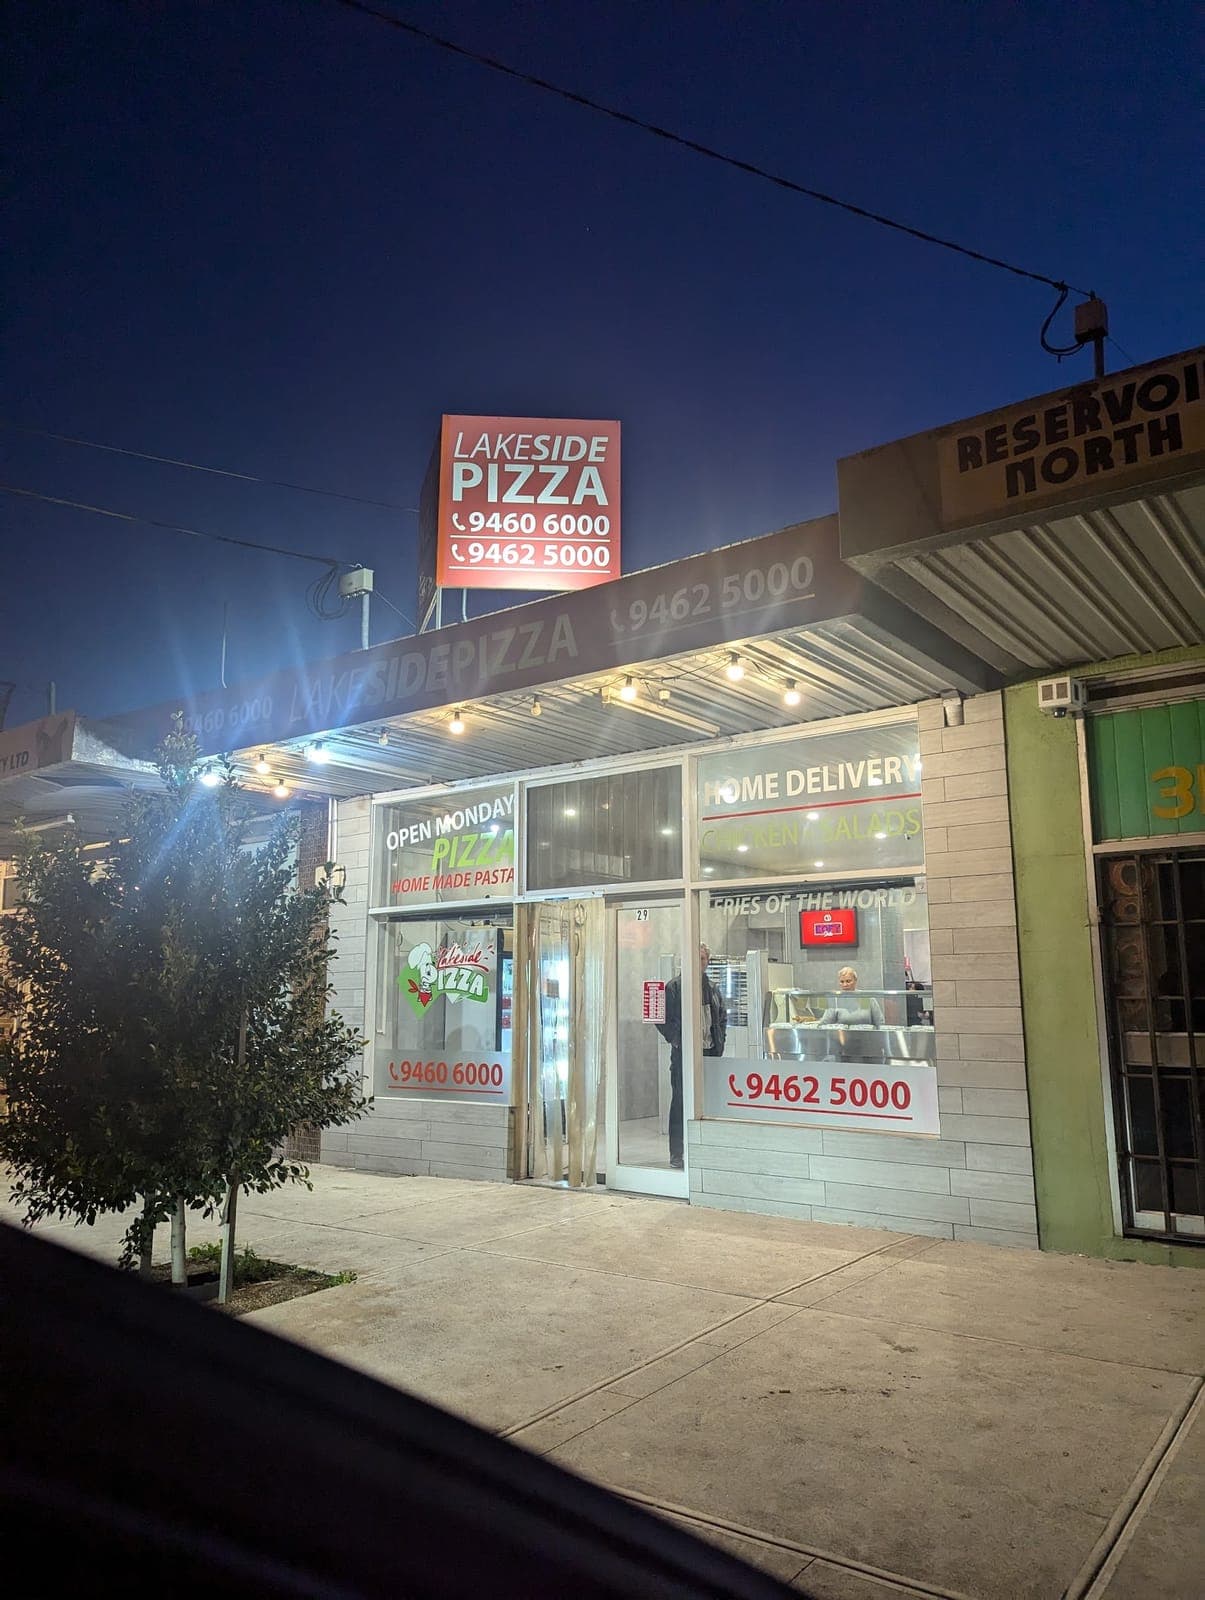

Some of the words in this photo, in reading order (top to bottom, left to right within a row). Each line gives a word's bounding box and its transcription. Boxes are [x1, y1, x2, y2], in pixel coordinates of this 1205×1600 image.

[957, 361, 1205, 474] RESERVOI
[453, 431, 609, 462] LAKESIDE
[1005, 412, 1183, 499] NORTH
[452, 462, 609, 506] PIZZA
[468, 512, 537, 535] 9460
[543, 513, 610, 537] 6000
[467, 542, 536, 566] 9462
[543, 543, 611, 568] 5000
[628, 583, 712, 632] 9462
[720, 555, 815, 602] 5000
[9, 750, 29, 770] LTD
[704, 772, 780, 806] HOME
[786, 753, 921, 797] DELIVERY
[386, 820, 431, 850] OPEN
[436, 793, 514, 836] MONDAY
[820, 808, 921, 843] SALADS
[432, 829, 514, 871] PIZZA
[392, 876, 431, 895] HOME
[432, 872, 471, 890] MADE
[474, 868, 514, 887] PASTA
[637, 909, 648, 921] 29
[765, 894, 792, 914] OF
[796, 890, 834, 913] THE
[838, 886, 916, 911] WORLD
[400, 1060, 448, 1084] 9460
[452, 1062, 503, 1086] 6000
[746, 1072, 820, 1104] 9462
[829, 1077, 912, 1110] 5000
